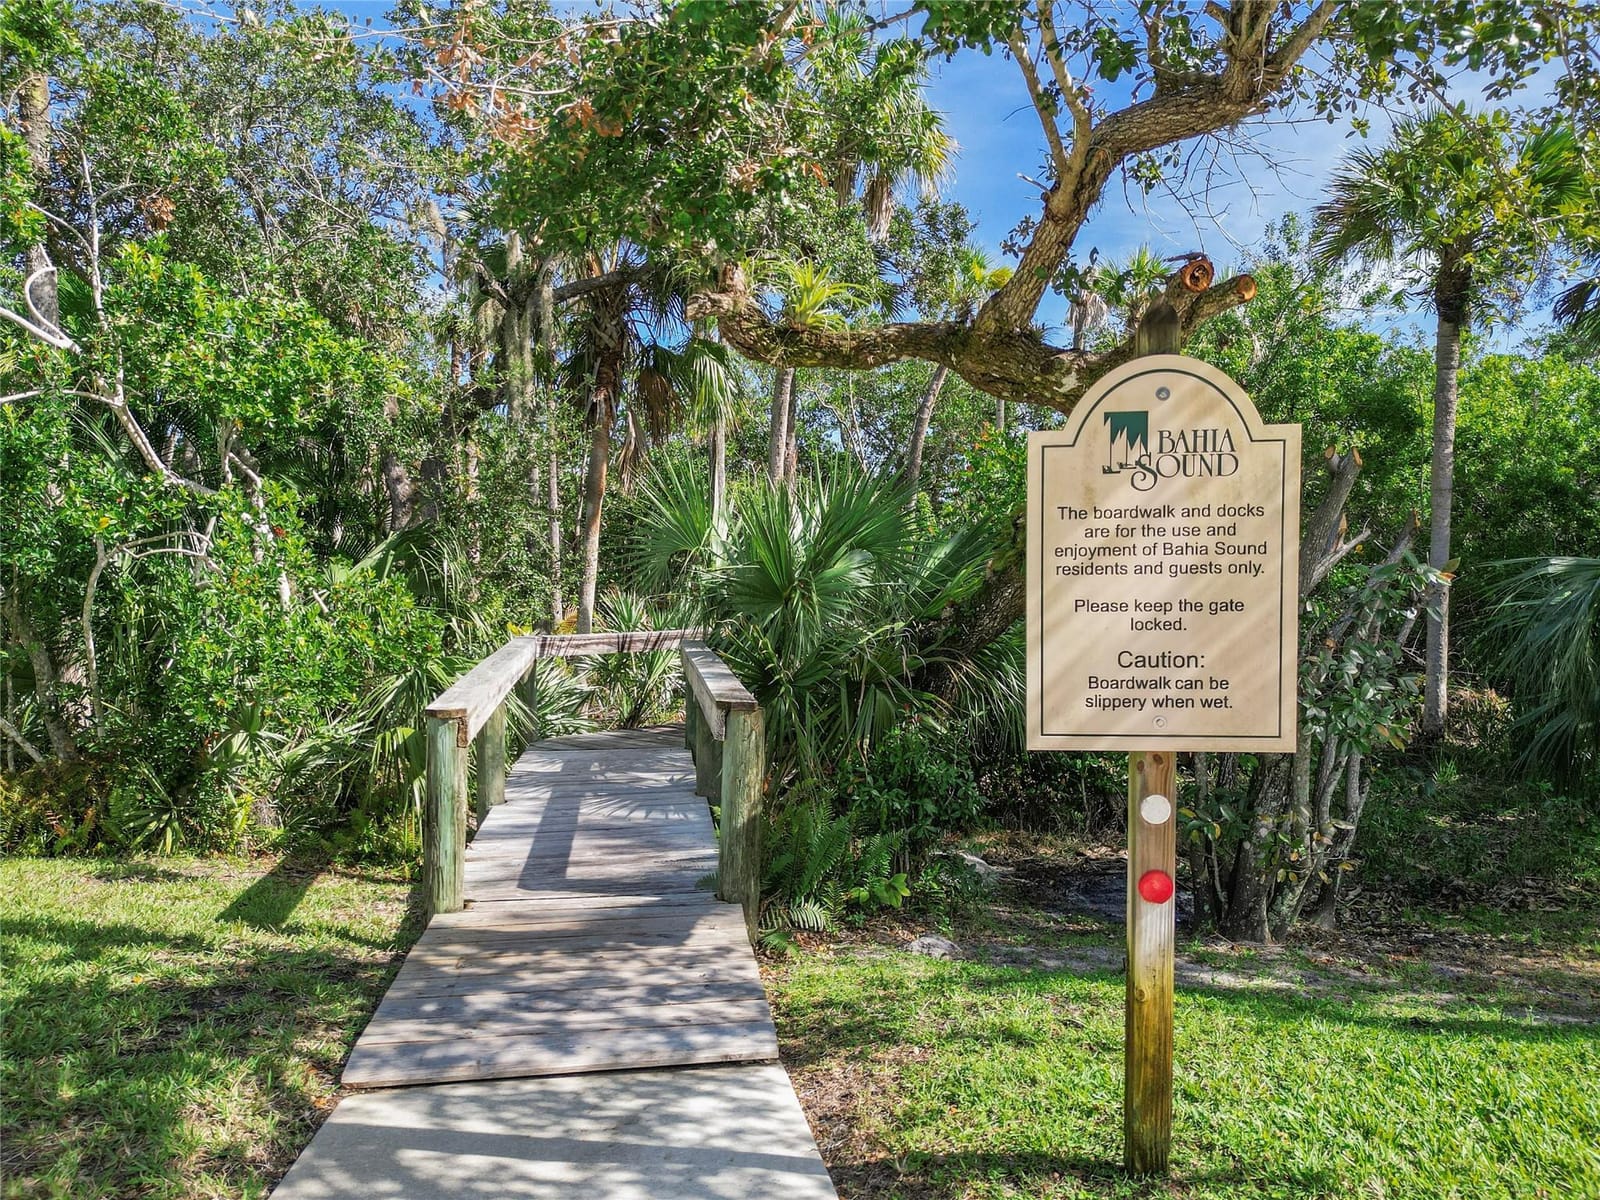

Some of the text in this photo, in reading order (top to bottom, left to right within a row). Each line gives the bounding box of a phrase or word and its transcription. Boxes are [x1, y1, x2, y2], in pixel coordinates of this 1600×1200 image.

[1158, 428, 1236, 453] BAHIA
[1130, 452, 1239, 492] SOUND
[1057, 503, 1265, 520] The boardwalk and docks
[1084, 522, 1236, 539] are for the use and
[1054, 542, 1267, 561] enjoyment of Bahia Sound
[1055, 561, 1265, 578] residents and guests only.
[1074, 598, 1244, 616] Please keep the gate
[1130, 618, 1187, 632] locked.
[1117, 651, 1206, 669] Caution:
[1087, 675, 1230, 690] Boardwalk can be
[1085, 694, 1233, 712] slippery when wet.
